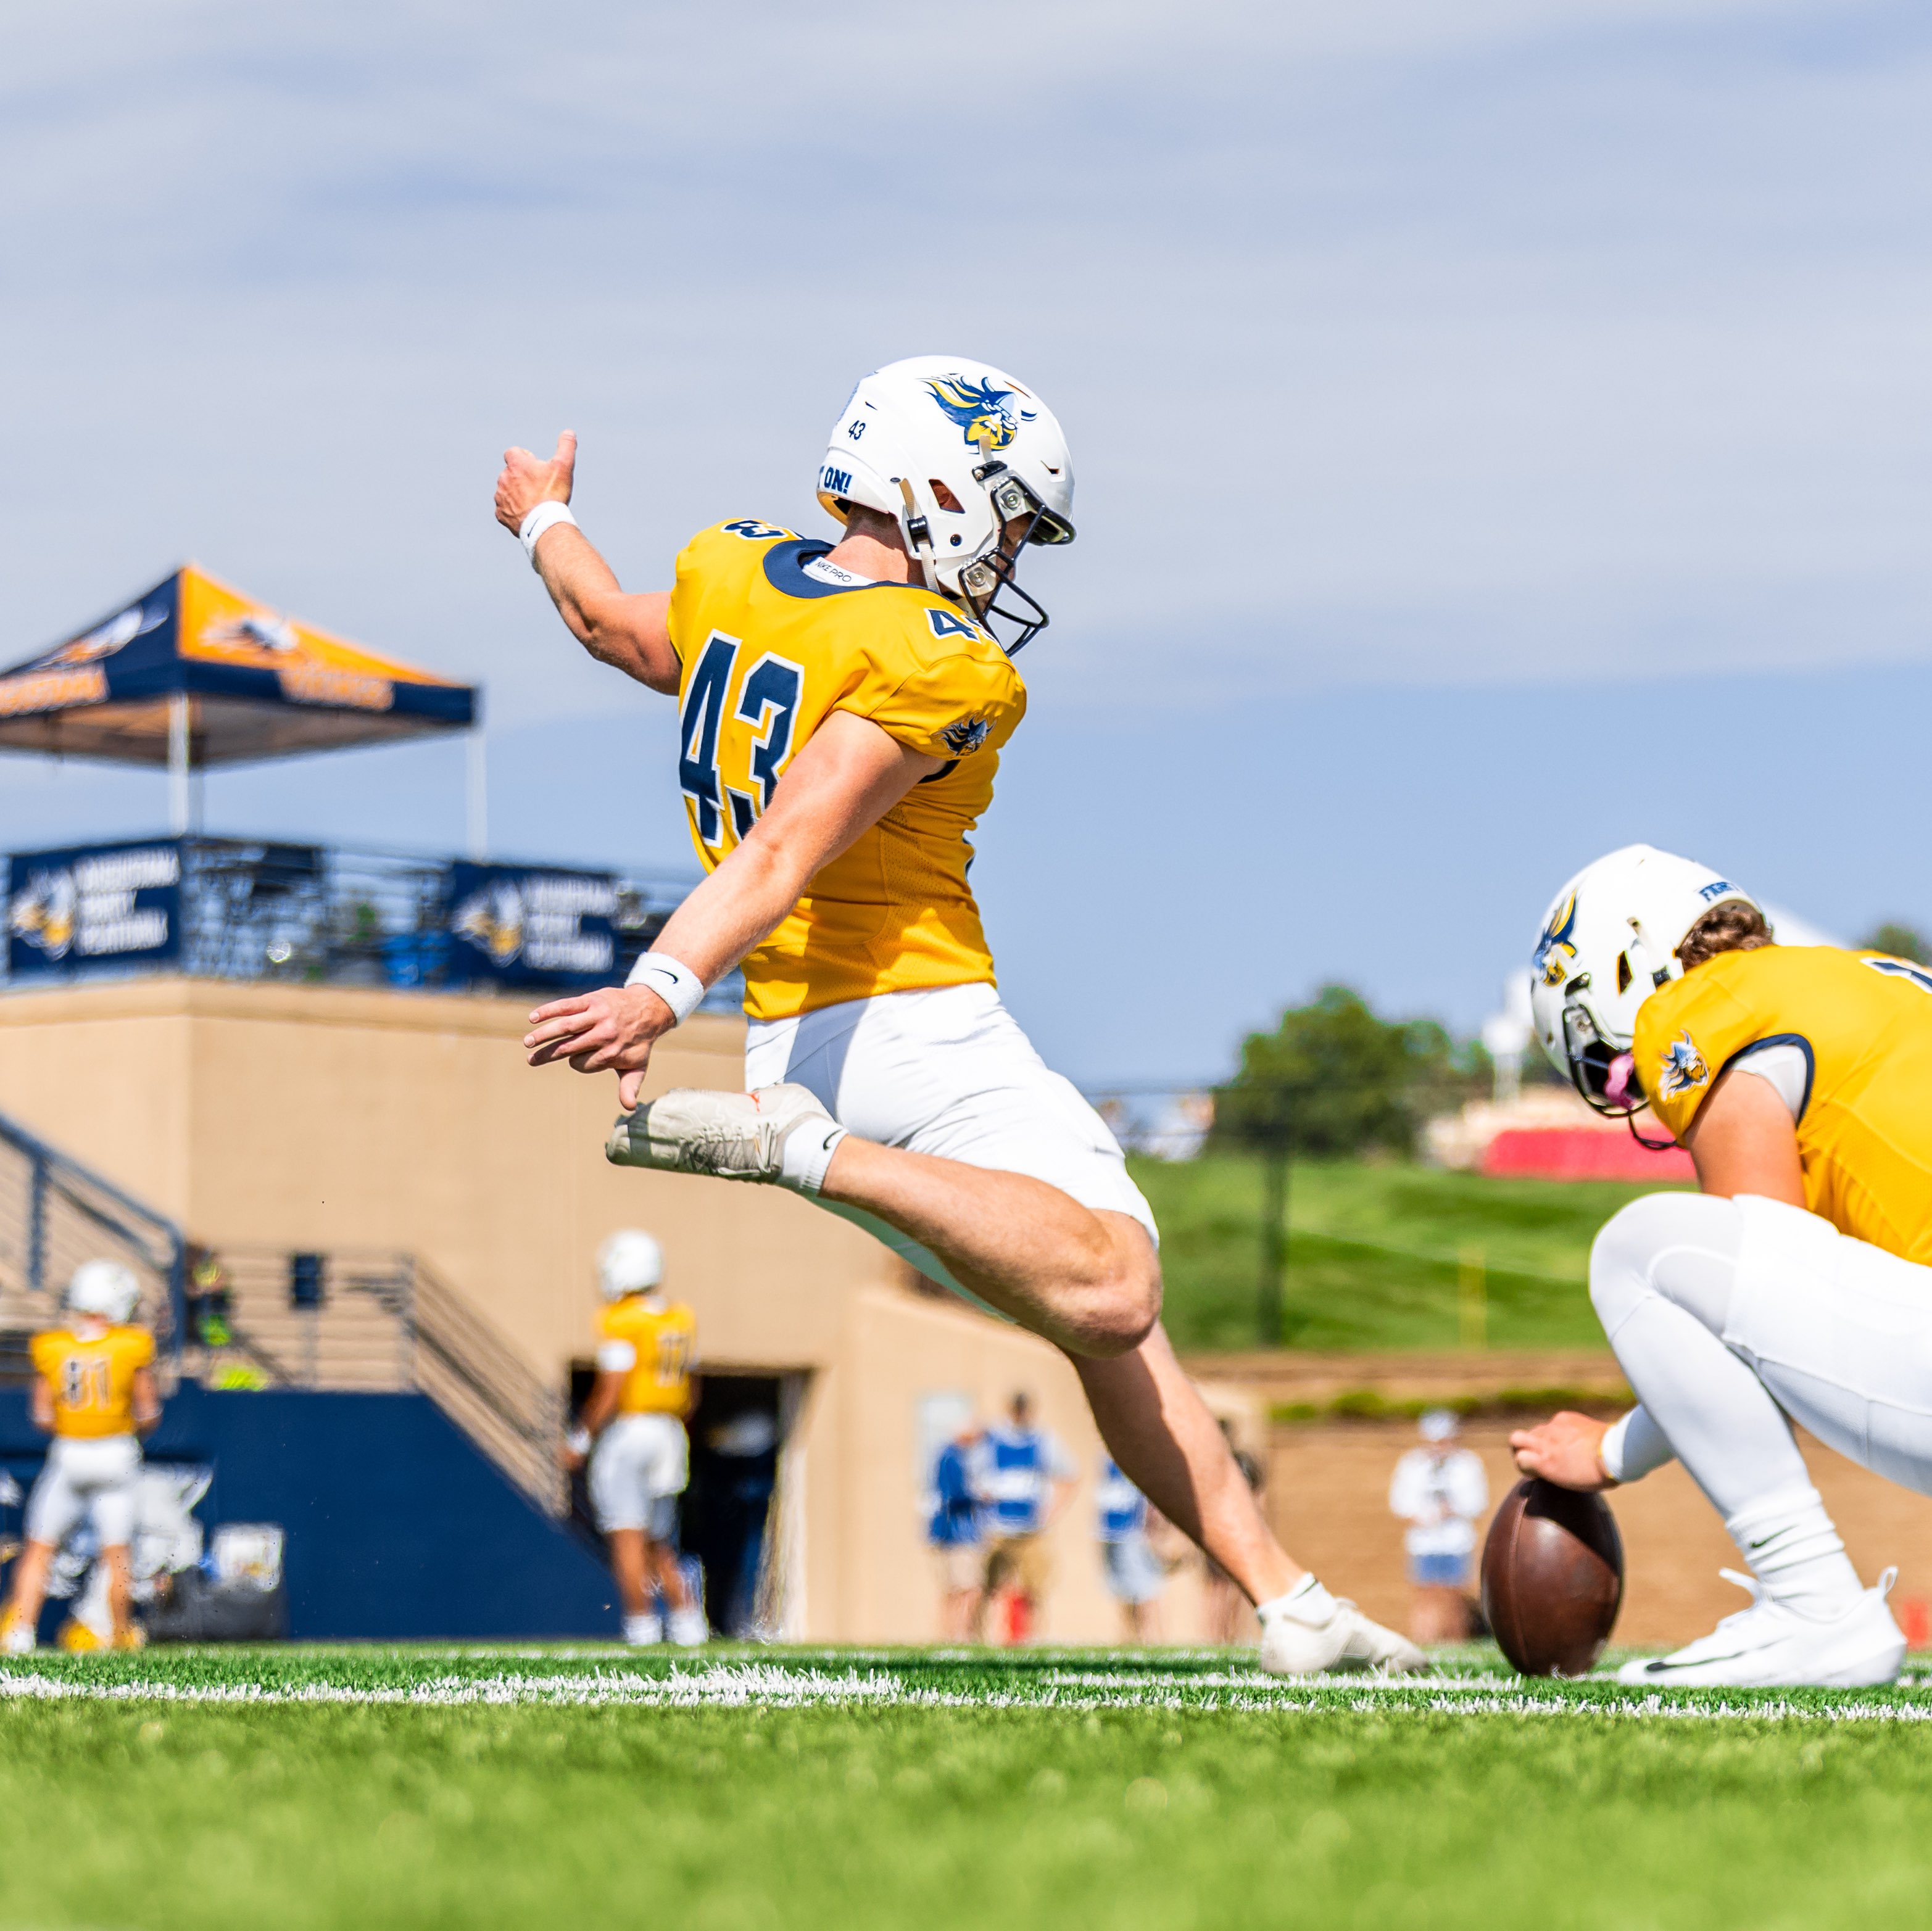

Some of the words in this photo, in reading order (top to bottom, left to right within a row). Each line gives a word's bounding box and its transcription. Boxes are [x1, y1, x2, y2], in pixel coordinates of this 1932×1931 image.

[848, 420, 866, 440] 43
[824, 466, 852, 494] ON!
[815, 561, 832, 572] NIKE
[829, 568, 852, 582] PRO
[679, 628, 805, 849] 43
